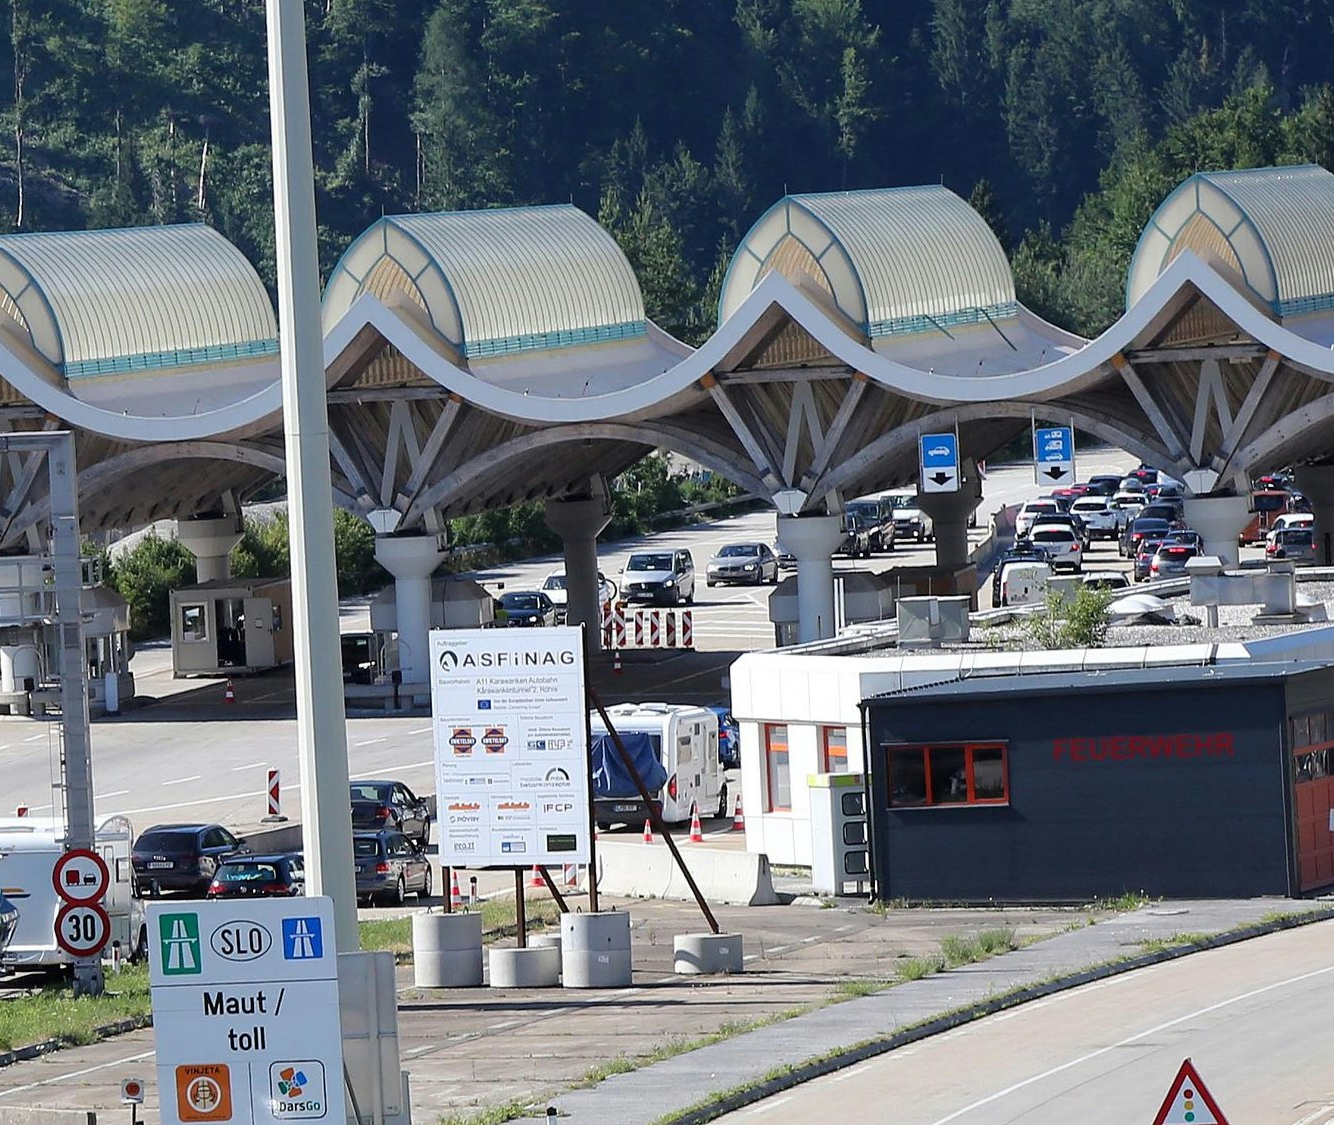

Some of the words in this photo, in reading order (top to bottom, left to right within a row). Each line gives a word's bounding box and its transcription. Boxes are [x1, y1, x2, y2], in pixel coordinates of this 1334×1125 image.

[1051, 732, 1235, 762] FEUERWEHR
[68, 914, 96, 942] 30
[221, 928, 262, 955] SLO
[203, 991, 267, 1016] Maut
[228, 1027, 266, 1051] toll
[278, 1101, 321, 1112] DarsGo
